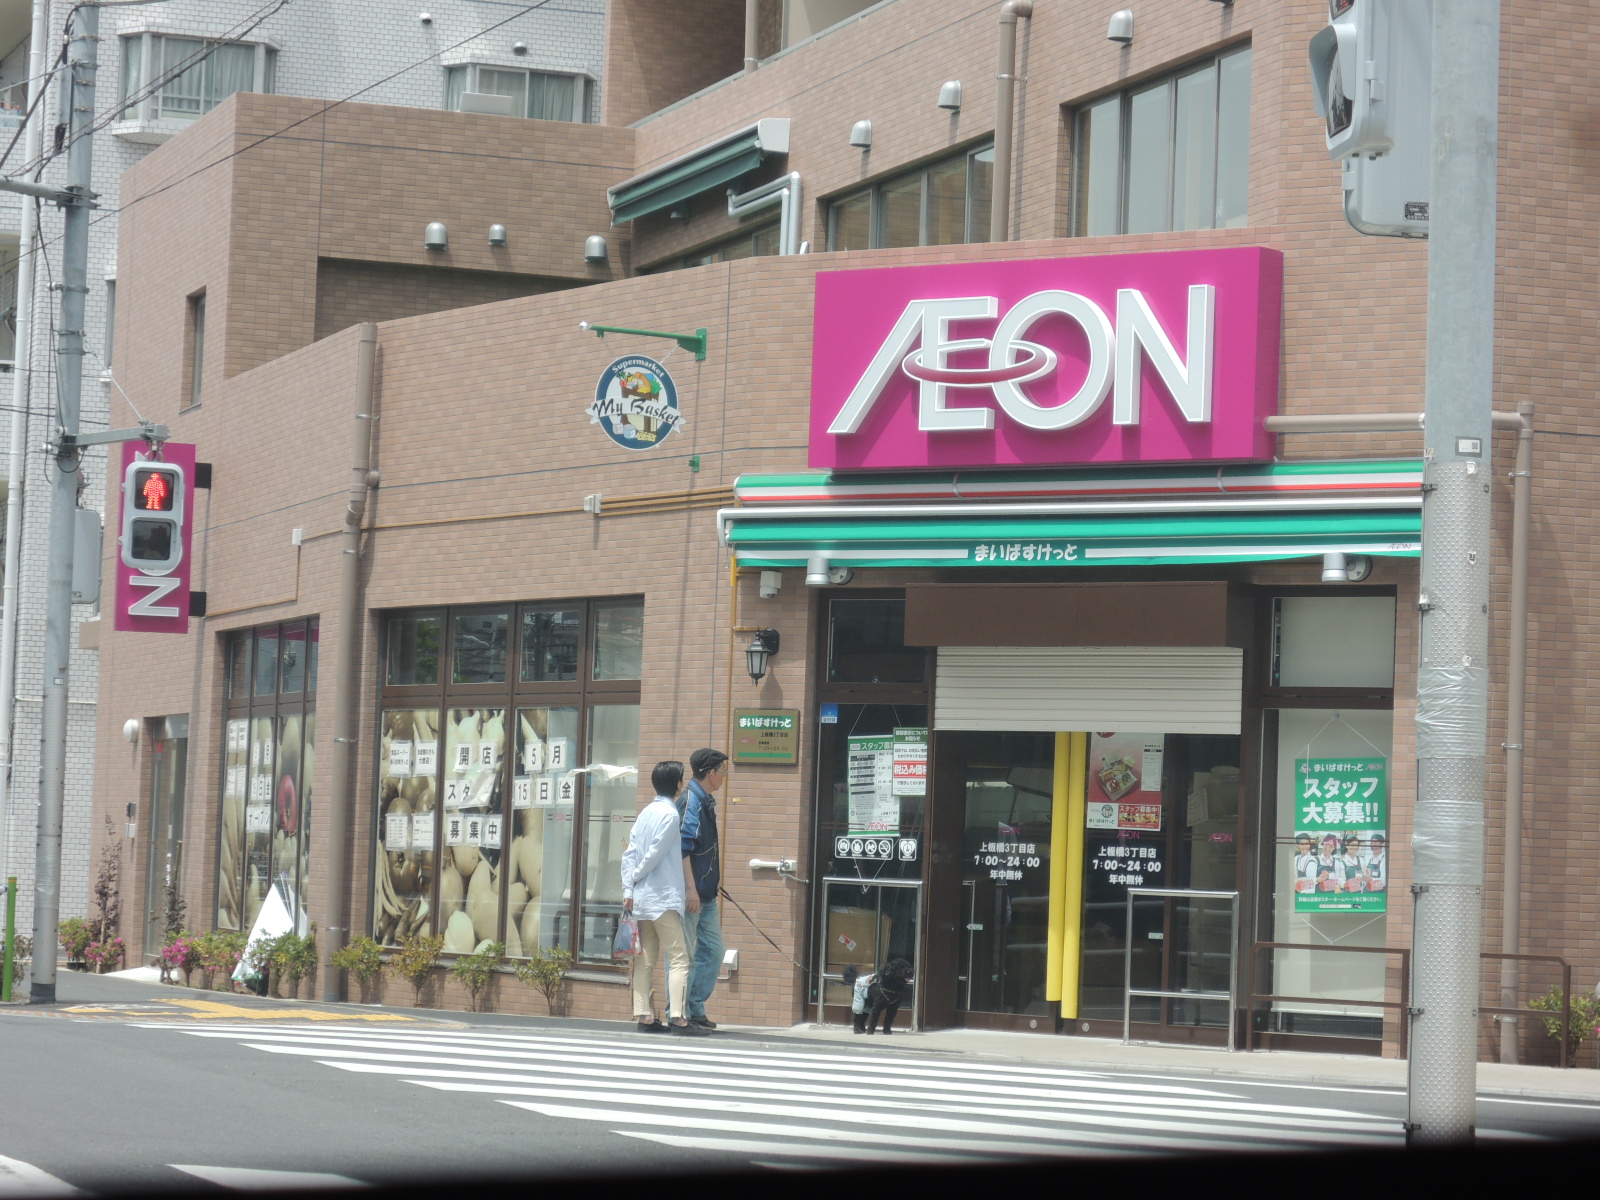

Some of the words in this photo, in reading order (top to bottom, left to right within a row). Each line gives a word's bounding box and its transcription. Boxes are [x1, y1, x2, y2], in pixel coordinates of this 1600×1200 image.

[612, 359, 665, 378] Supermarket
[592, 398, 624, 418] My
[631, 398, 680, 426] Basket
[974, 543, 1078, 562] まいばすけっと
[739, 717, 792, 728] まいばすけっと
[1313, 763, 1364, 772] まいばすけっと
[1302, 777, 1379, 799] スタッフ
[450, 820, 498, 840] 募集中
[979, 842, 1036, 854] 上板橋3丁目店
[1098, 846, 1157, 858] 上板橋3丁目店
[989, 870, 1023, 880] 年中無休
[1109, 874, 1144, 885] 年中無休
